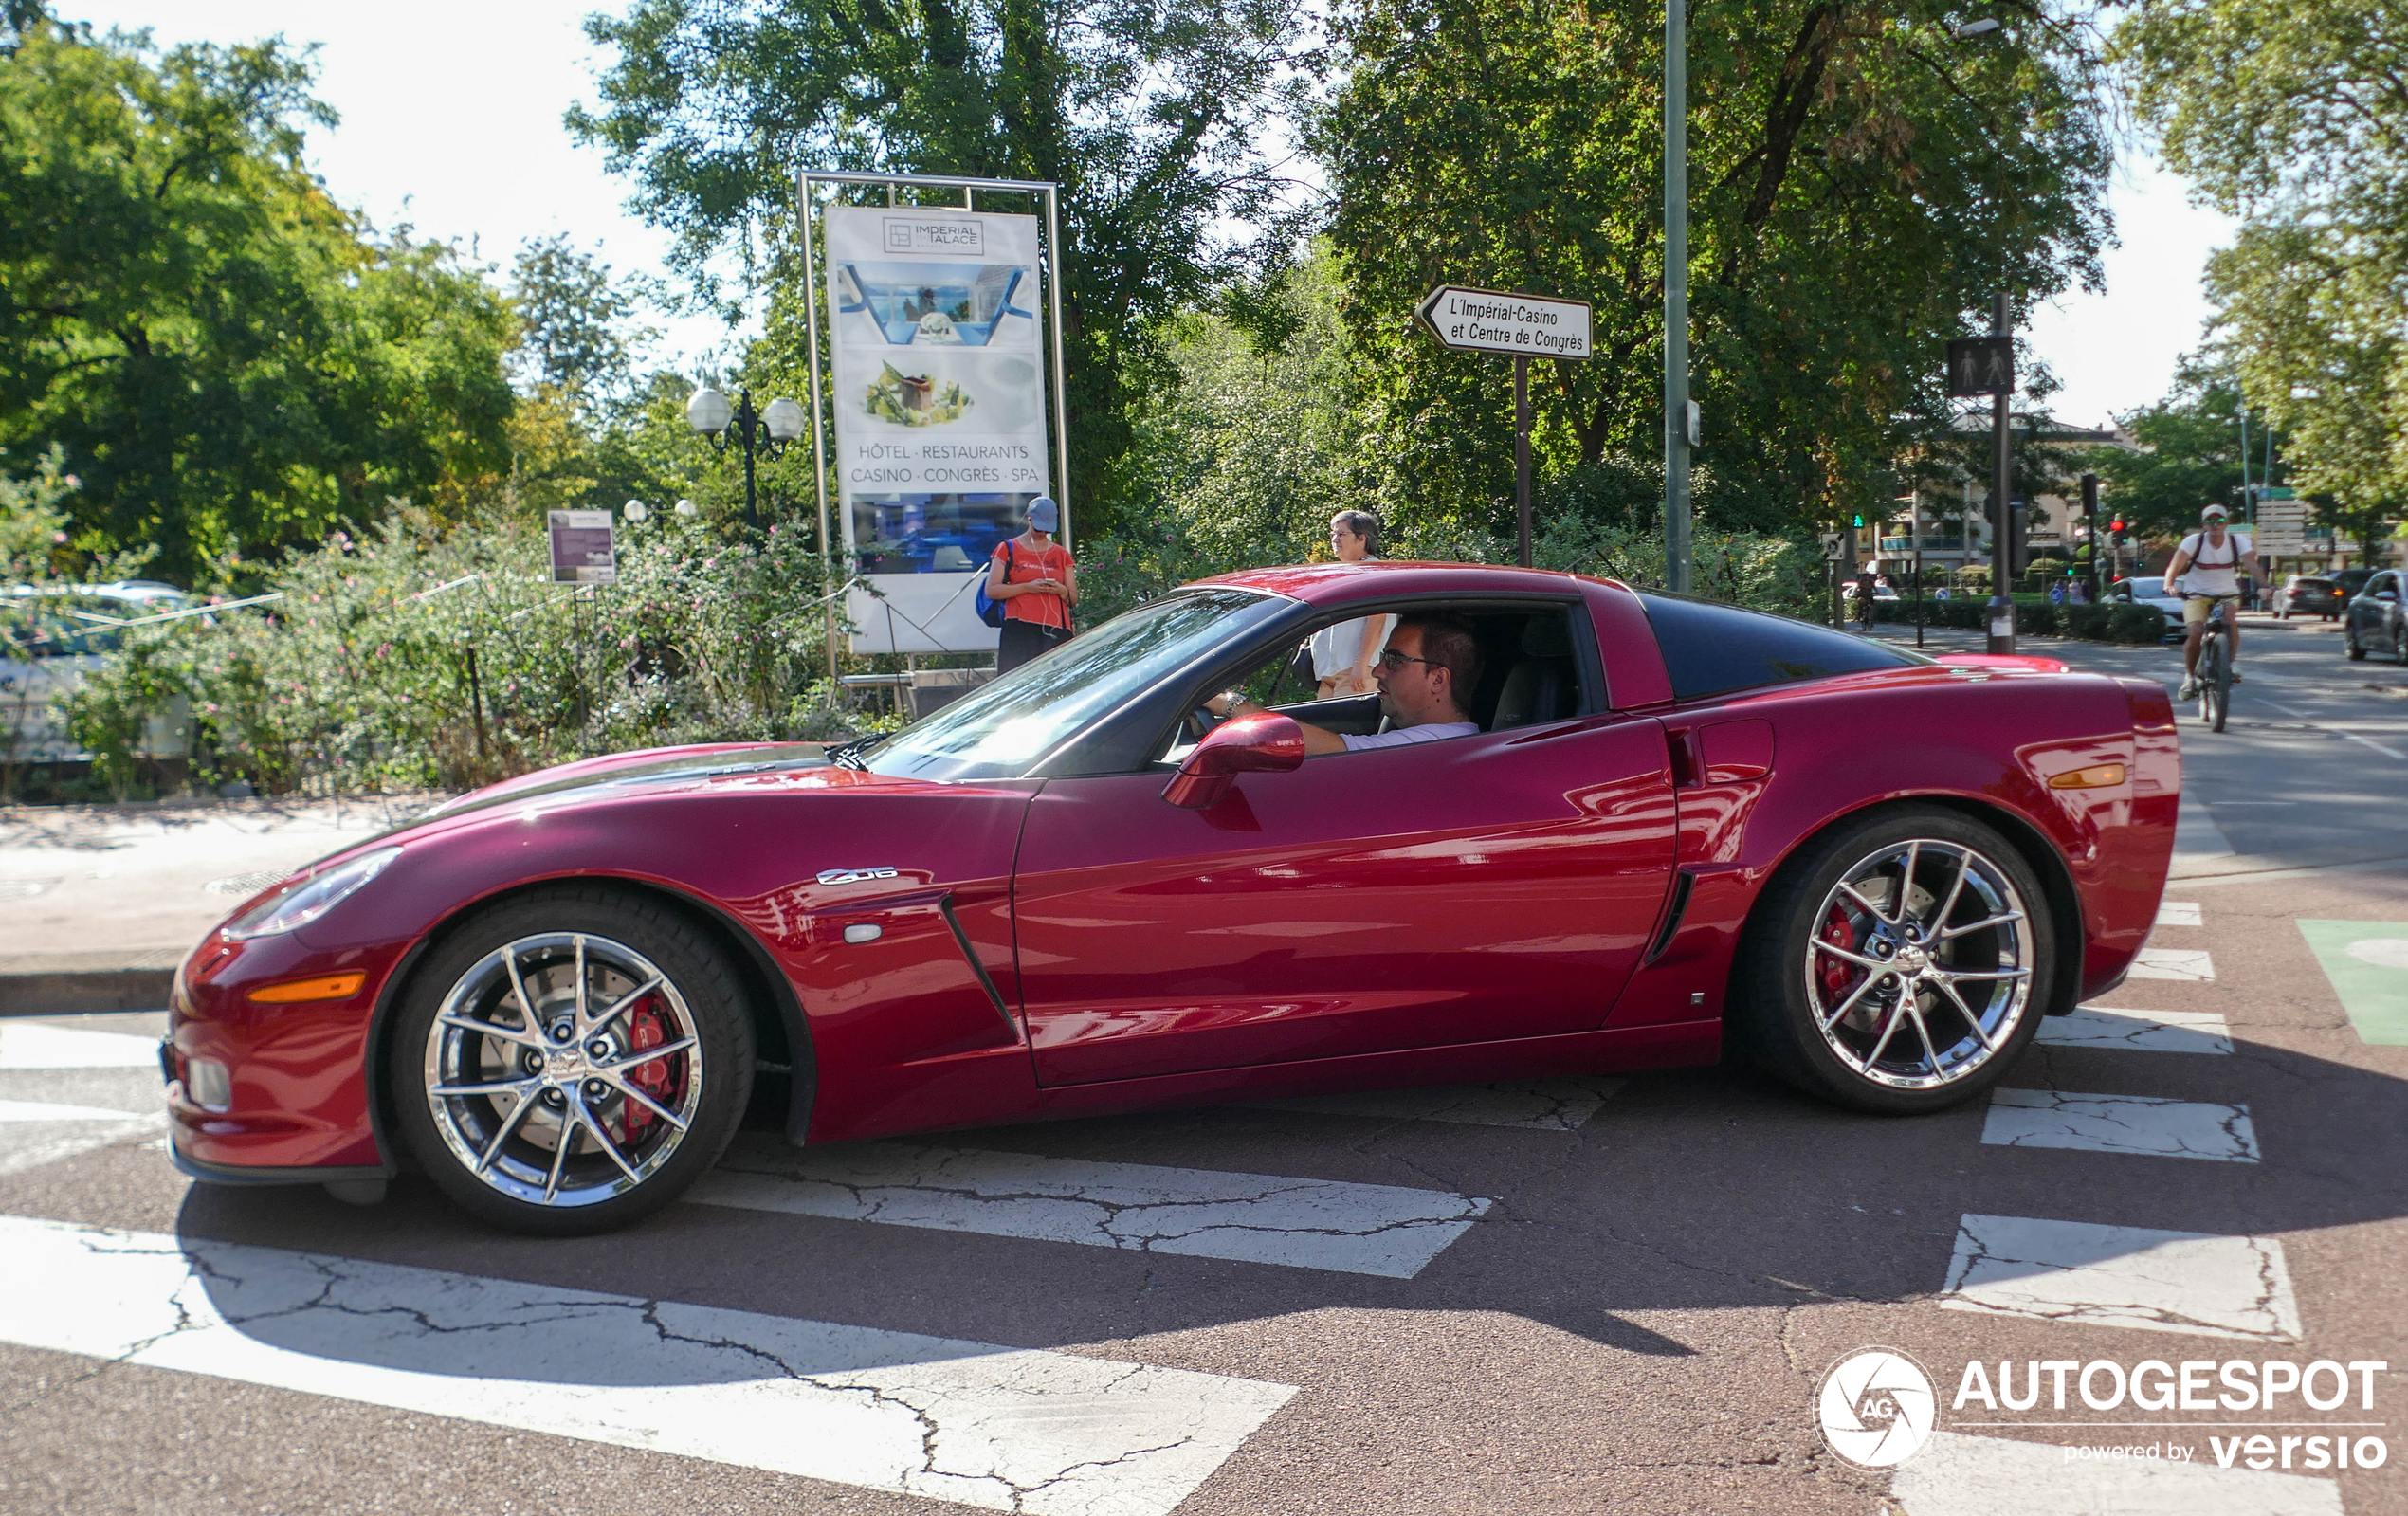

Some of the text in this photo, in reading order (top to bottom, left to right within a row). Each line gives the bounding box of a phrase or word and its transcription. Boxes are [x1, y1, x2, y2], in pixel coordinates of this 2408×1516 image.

[916, 226, 977, 237] IMPERIAL
[1450, 298, 1558, 325] L'Impérial-Casino
[1451, 323, 1583, 353] et Centre de Congrès
[859, 443, 1029, 459] HÔTEL RESTAURANTS
[851, 466, 1039, 482] CASINO CONGRÈS SPA
[815, 866, 899, 886] Z06
